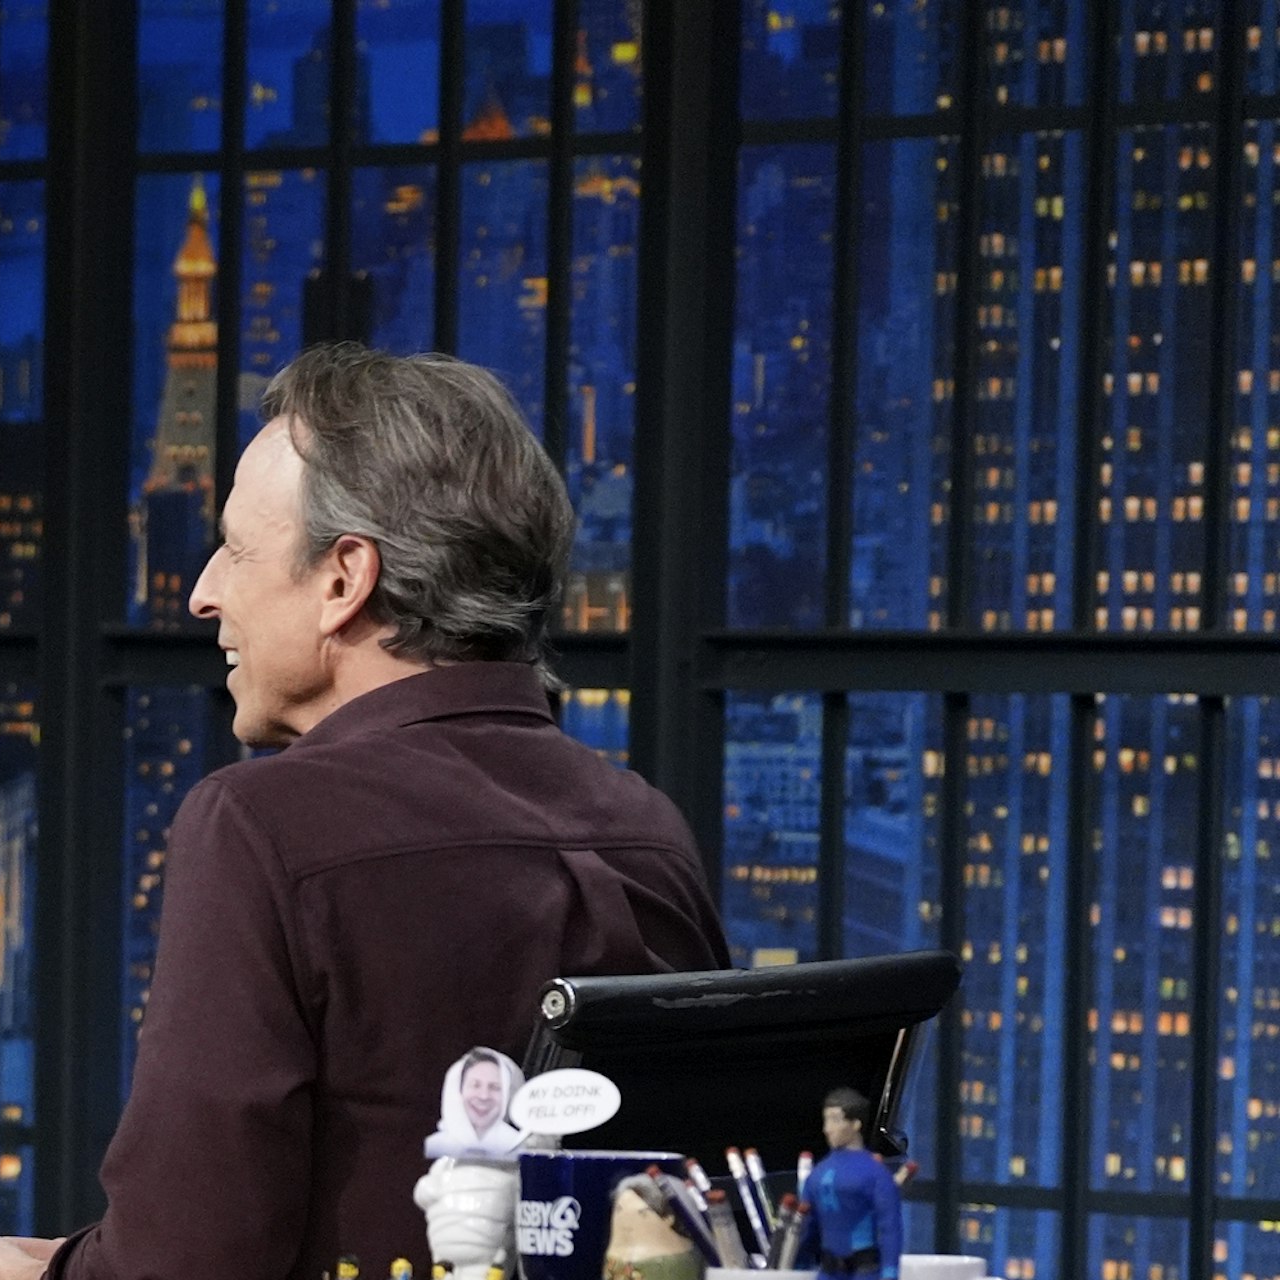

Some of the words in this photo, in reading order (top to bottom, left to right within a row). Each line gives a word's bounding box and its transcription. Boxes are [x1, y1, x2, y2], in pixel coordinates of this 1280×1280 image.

[529, 1087, 549, 1100] MY
[552, 1085, 603, 1099] DOINK
[527, 1105, 559, 1119] FELL
